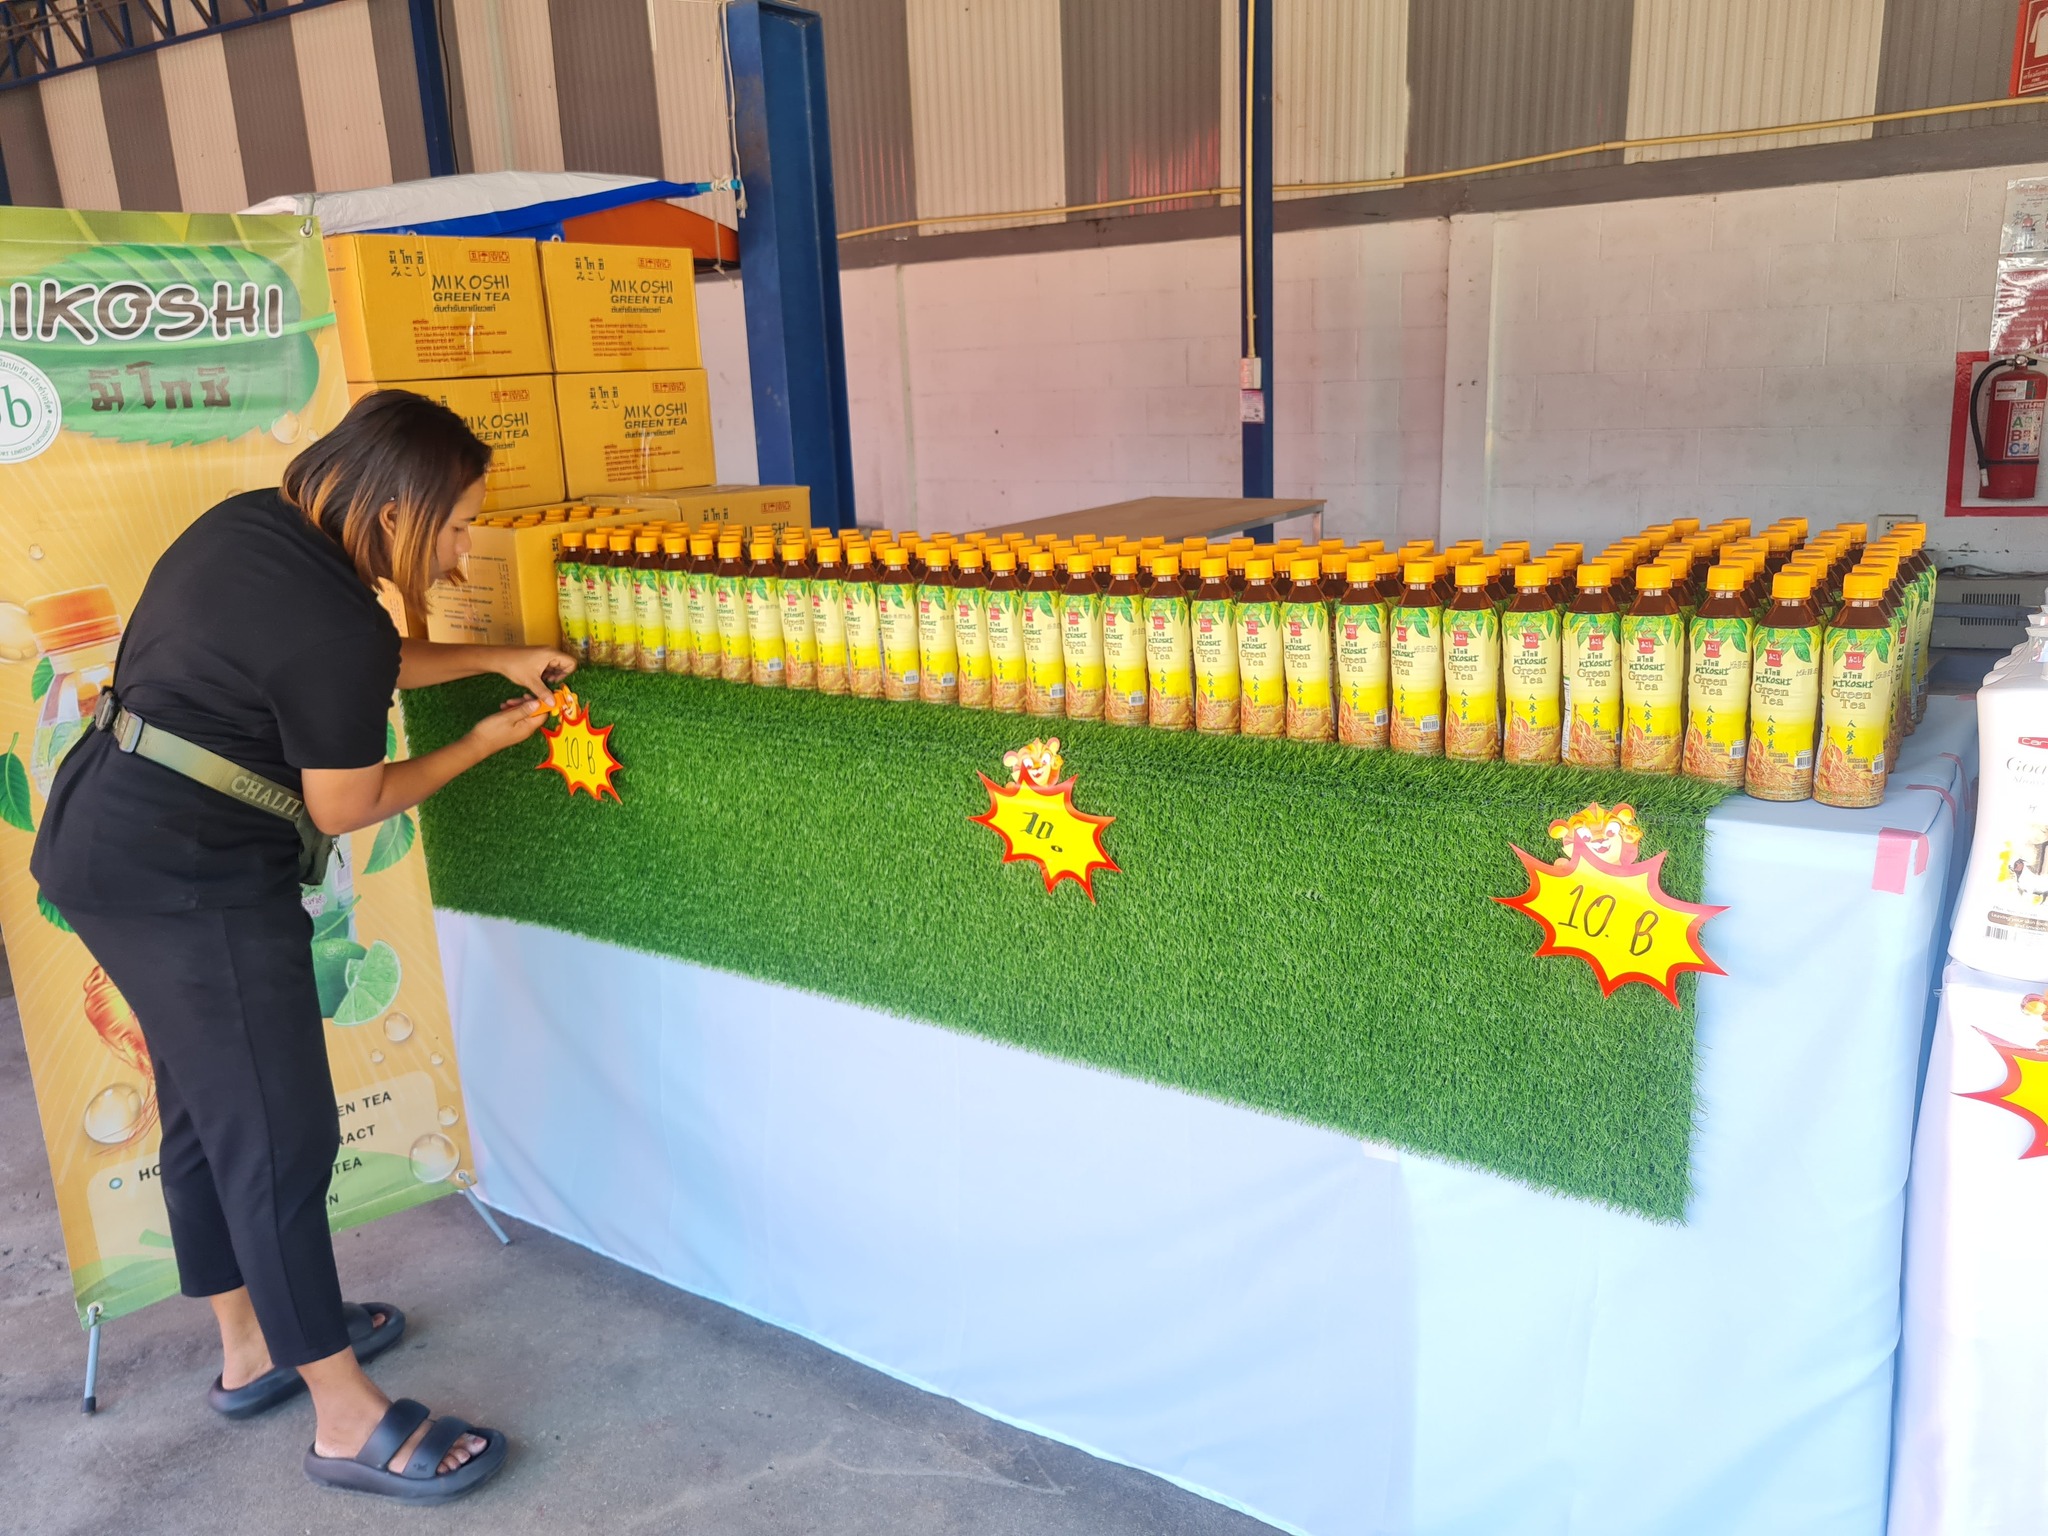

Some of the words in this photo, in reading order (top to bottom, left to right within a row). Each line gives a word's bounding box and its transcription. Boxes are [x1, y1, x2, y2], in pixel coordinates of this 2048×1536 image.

[433, 292, 481, 302] GREEN
[486, 292, 511, 302] TEA
[611, 296, 650, 304] GREEN
[654, 296, 673, 304] TEA
[0, 278, 284, 345] IKOSHI
[0, 384, 32, 428] b
[625, 418, 664, 429] GREEN
[668, 418, 687, 427] TEA
[2012, 416, 2023, 428] A
[477, 432, 502, 441] EEN
[506, 430, 529, 439] TEA
[2011, 430, 2022, 441] B
[2009, 443, 2020, 455] C
[1453, 672, 1474, 681] Tea
[1696, 666, 1730, 676] MIKOSHI
[1520, 675, 1543, 685] Tea
[1586, 678, 1607, 687] Tea
[1628, 672, 1663, 682] Green
[1694, 676, 1728, 687] Green
[1756, 676, 1792, 686] MIKOSHI
[1636, 681, 1659, 691] Tea
[1832, 680, 1874, 689] MIKOSHI
[1700, 686, 1723, 696] Tea
[1754, 684, 1789, 697] Green
[1831, 688, 1872, 700] Green
[1761, 695, 1784, 706] Tea
[1840, 699, 1866, 710] Tea
[2022, 738, 2048, 746] Car
[2006, 757, 2047, 775] Goa
[231, 776, 303, 816] CHALIT
[338, 1102, 356, 1117] EN
[362, 1091, 392, 1109] TEA
[334, 1156, 362, 1175] TEA
[138, 1164, 161, 1181] HO
